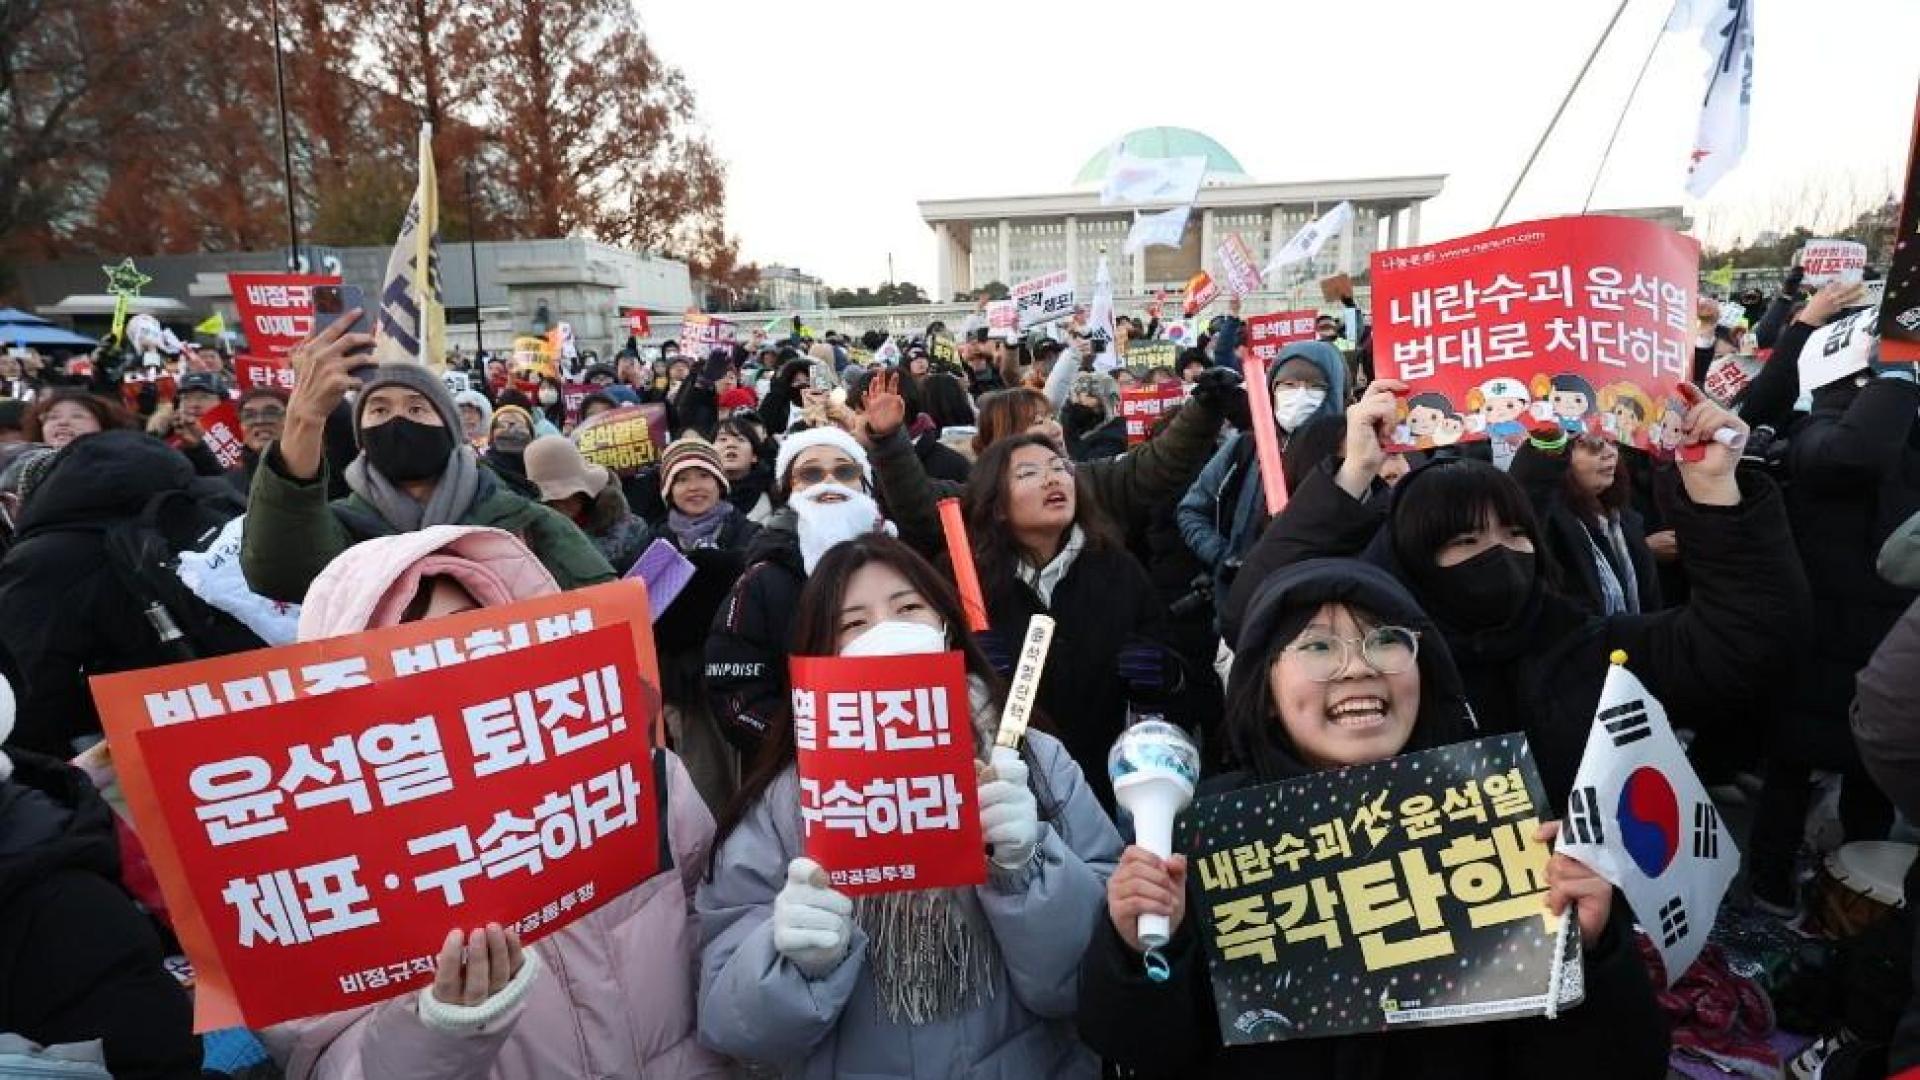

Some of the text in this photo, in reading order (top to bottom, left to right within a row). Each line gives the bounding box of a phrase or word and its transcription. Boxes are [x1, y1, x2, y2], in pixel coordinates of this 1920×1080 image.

[245, 285, 313, 308] 비정규
[254, 315, 314, 337] 이제그
[1389, 264, 1689, 334] 내란수괴 윤석열
[1393, 321, 1534, 382] 법대로
[827, 686, 952, 751] 퇴진!
[188, 664, 628, 847] 윤석열 퇴진!
[1196, 767, 1534, 891] 내란수괴 윤석열
